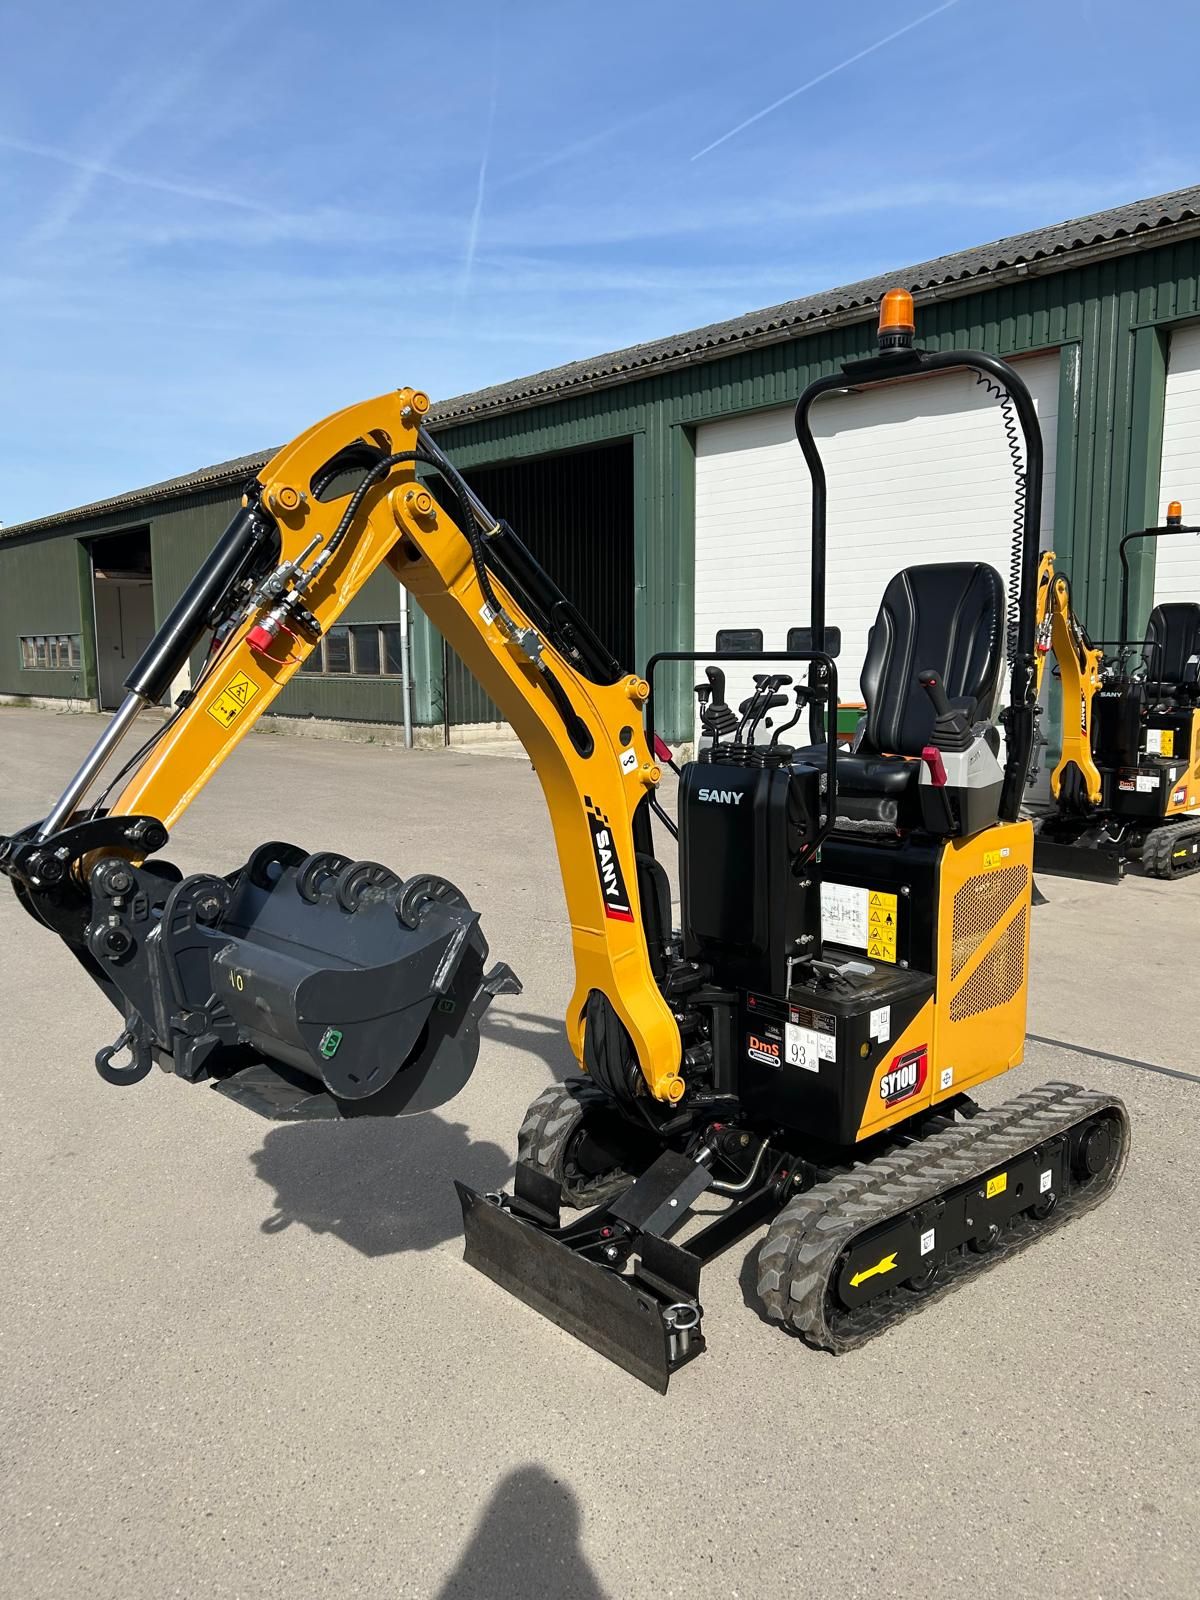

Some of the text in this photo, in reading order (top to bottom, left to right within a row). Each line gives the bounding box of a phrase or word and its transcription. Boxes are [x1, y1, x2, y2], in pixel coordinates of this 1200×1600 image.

[698, 788, 744, 805] SANY
[596, 829, 620, 897] SANY
[750, 1036, 779, 1056] DmS
[791, 1043, 805, 1064] 93
[880, 1062, 917, 1098] SY10U
